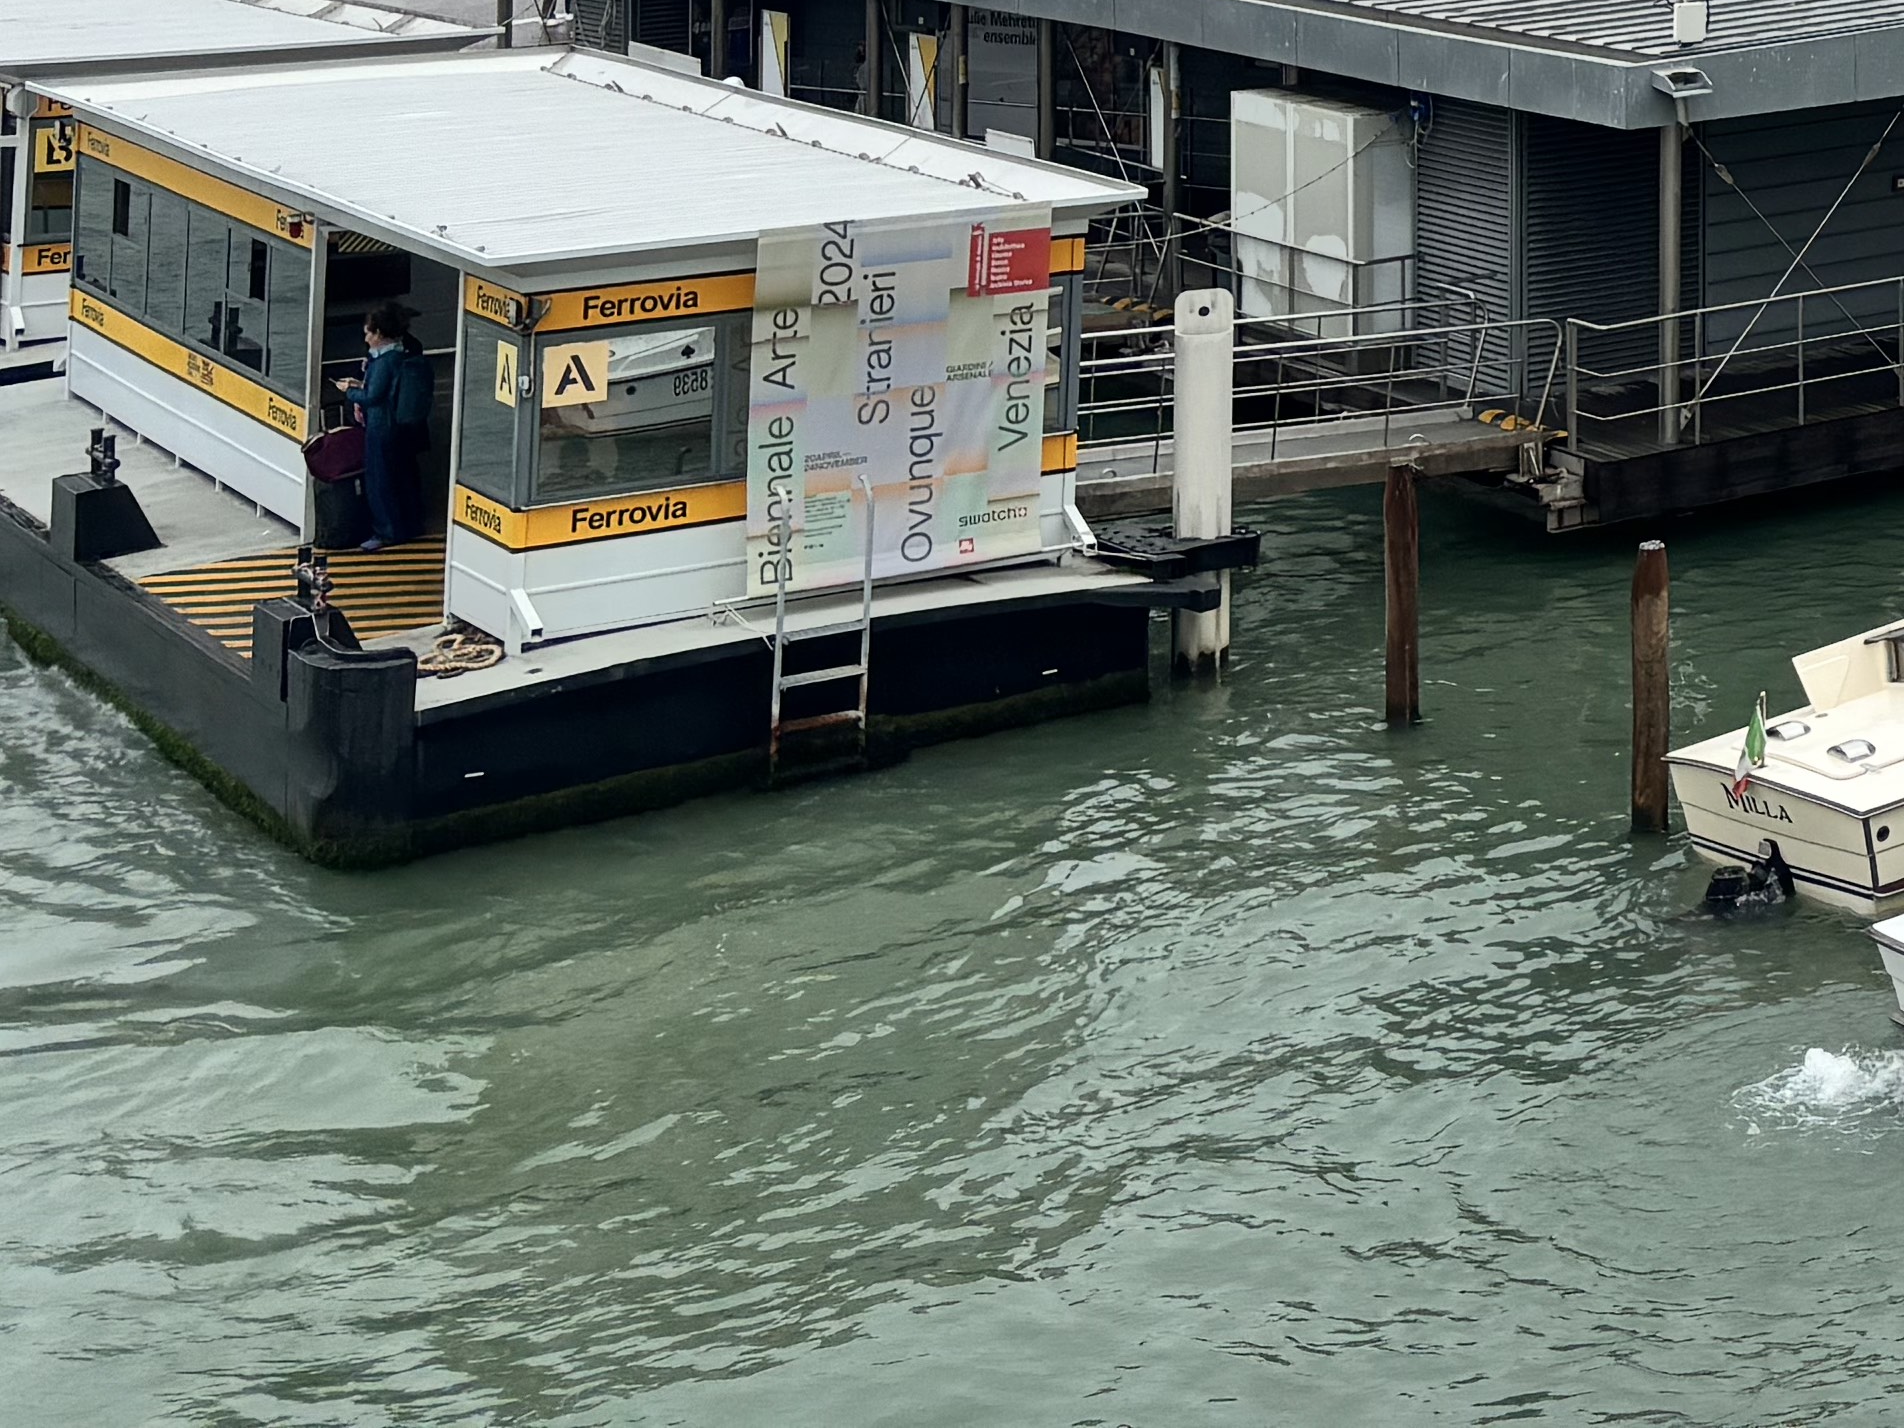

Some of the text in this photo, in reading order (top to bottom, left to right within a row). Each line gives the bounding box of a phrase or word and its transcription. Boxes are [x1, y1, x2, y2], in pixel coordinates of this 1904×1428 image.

[582, 286, 699, 321] Ferrovia
[762, 307, 800, 390] Arte
[857, 270, 897, 426] Stranieri
[499, 353, 513, 396] A
[554, 354, 596, 396] A
[997, 302, 1035, 452] Venezia
[900, 384, 944, 563] Ovunque
[464, 495, 502, 534] Ferrovia
[571, 496, 688, 533] Ferrovia
[958, 505, 1017, 528] swatch
[1720, 781, 1794, 824] MILLA
